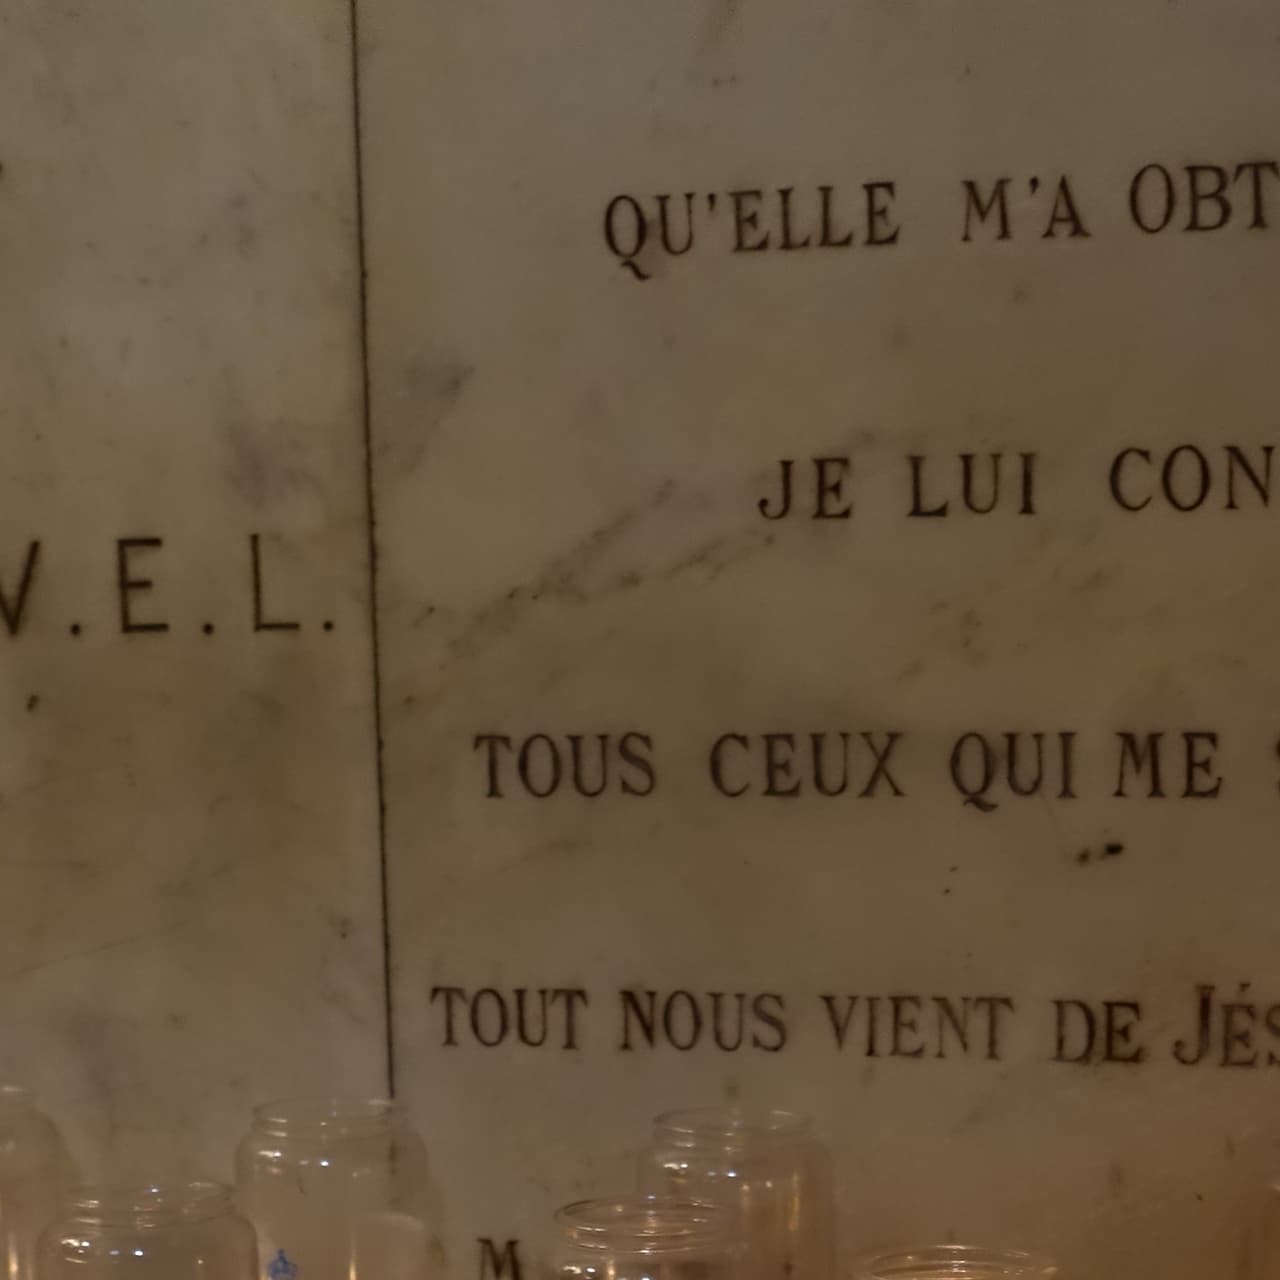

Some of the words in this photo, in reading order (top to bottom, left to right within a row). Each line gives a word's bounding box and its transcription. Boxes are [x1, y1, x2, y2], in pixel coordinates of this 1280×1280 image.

[603, 181, 900, 282] QU'ELLE
[962, 175, 1091, 242] M'A
[758, 456, 852, 520] JE
[906, 452, 1036, 518] LUI
[473, 731, 657, 799] TOUS
[708, 731, 904, 799] CEUX
[948, 731, 1076, 813] QUI
[1113, 731, 1223, 798] ME
[430, 986, 588, 1050] TOUT
[618, 989, 787, 1053] NOUS
[818, 994, 1015, 1061] VIENT
[1052, 999, 1147, 1066] DE
